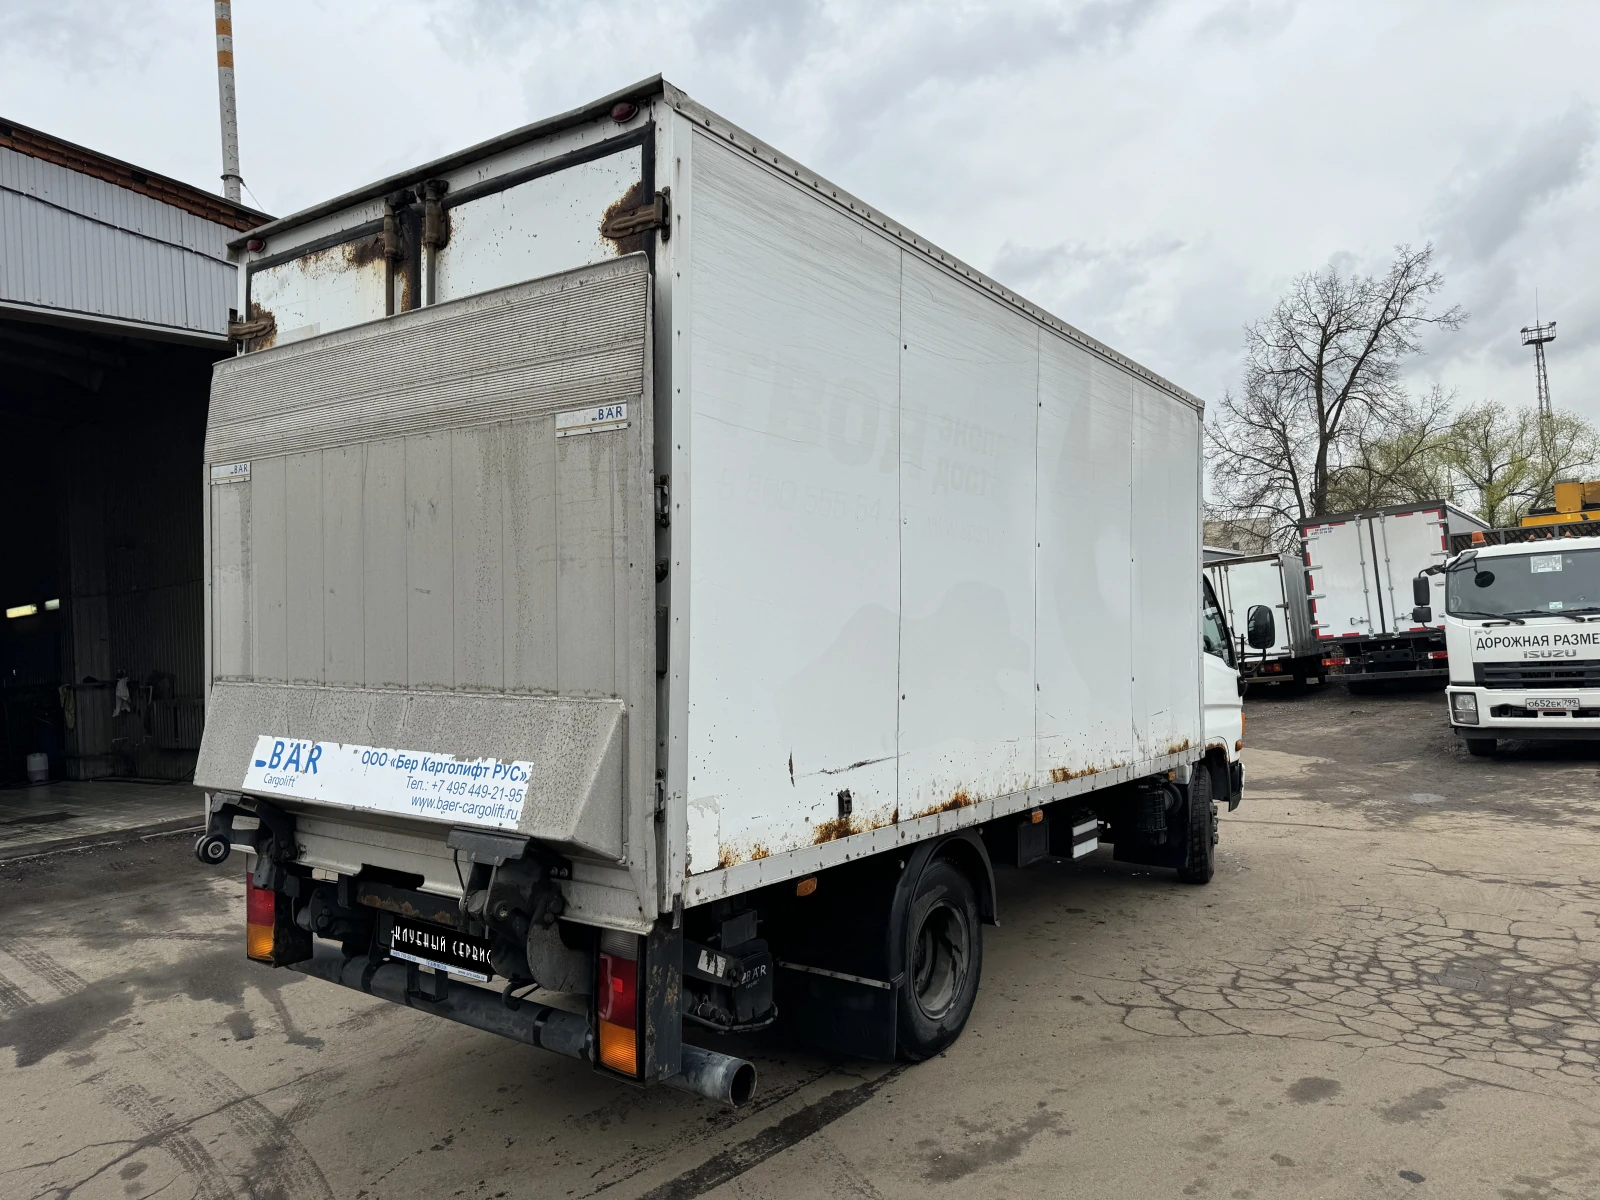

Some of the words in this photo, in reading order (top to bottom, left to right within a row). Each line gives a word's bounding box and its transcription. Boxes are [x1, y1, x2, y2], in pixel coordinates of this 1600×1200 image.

[598, 406, 623, 420] BÄR
[1476, 635, 1550, 651] ДОРОЖНАЯ
[1553, 632, 1600, 646] РАЗМЕ
[1523, 648, 1577, 659] ISUZU
[267, 740, 323, 775] BÄR
[361, 750, 388, 767] ООО
[390, 754, 419, 774] «Бер
[420, 756, 490, 781] Карголифт
[492, 763, 527, 782] РУС»
[263, 772, 296, 788] Cargolift
[406, 775, 430, 791] Тел.:
[431, 779, 446, 793] +7
[446, 781, 468, 796] 495
[467, 783, 524, 803] 449-21-95
[411, 795, 519, 821] www.baer-cargolift.ru
